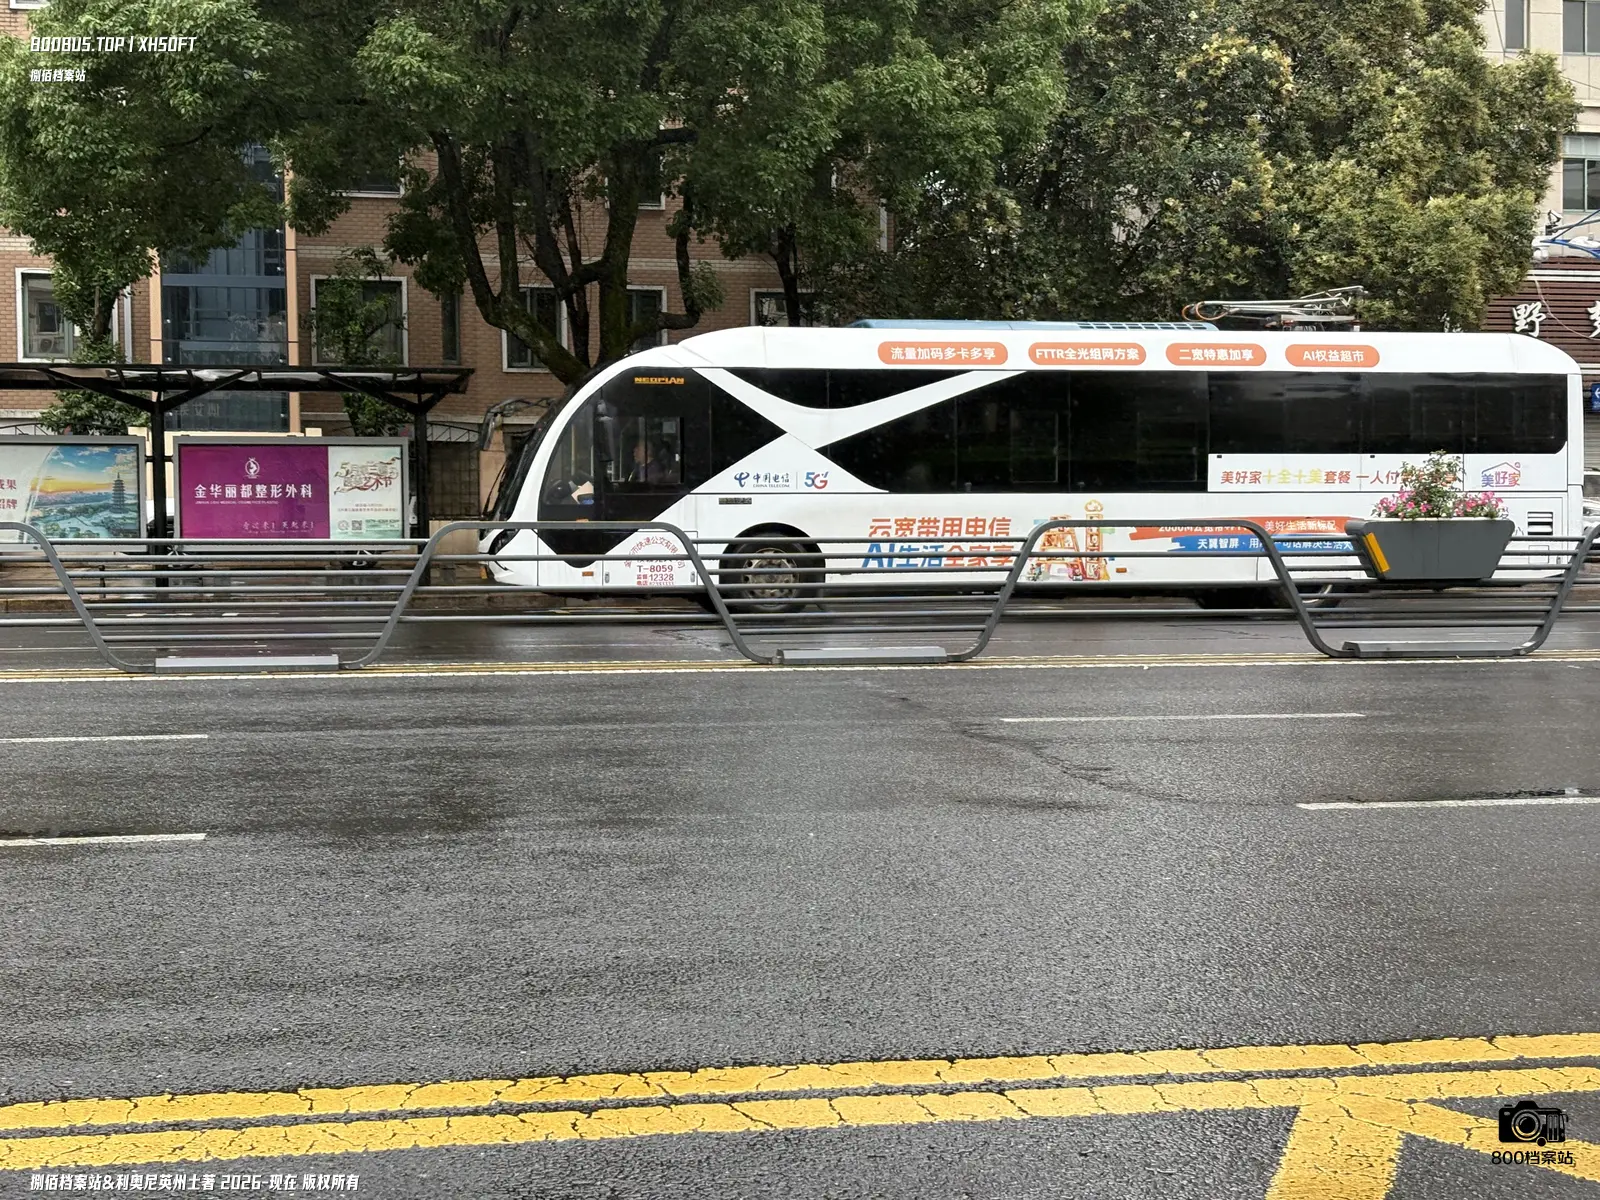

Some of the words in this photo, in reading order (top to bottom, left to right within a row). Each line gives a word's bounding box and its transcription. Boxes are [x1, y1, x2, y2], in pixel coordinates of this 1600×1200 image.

[890, 346, 996, 361] 流量加码多卡多享
[1035, 348, 1139, 361] FTTR全光组网方案
[1179, 348, 1254, 362] 二宽特惠加享
[1303, 349, 1364, 363] AI权益超市
[753, 473, 790, 484] 中国电信
[804, 471, 829, 489] 5G
[1221, 468, 1351, 484] 美好家十全十美套餐
[1481, 471, 1521, 488] 美好家
[194, 483, 313, 499] 金华丽都整形外科
[1265, 520, 1337, 531] 美好生活新标配
[636, 564, 674, 573] T-8059
[648, 573, 675, 582] 12328
